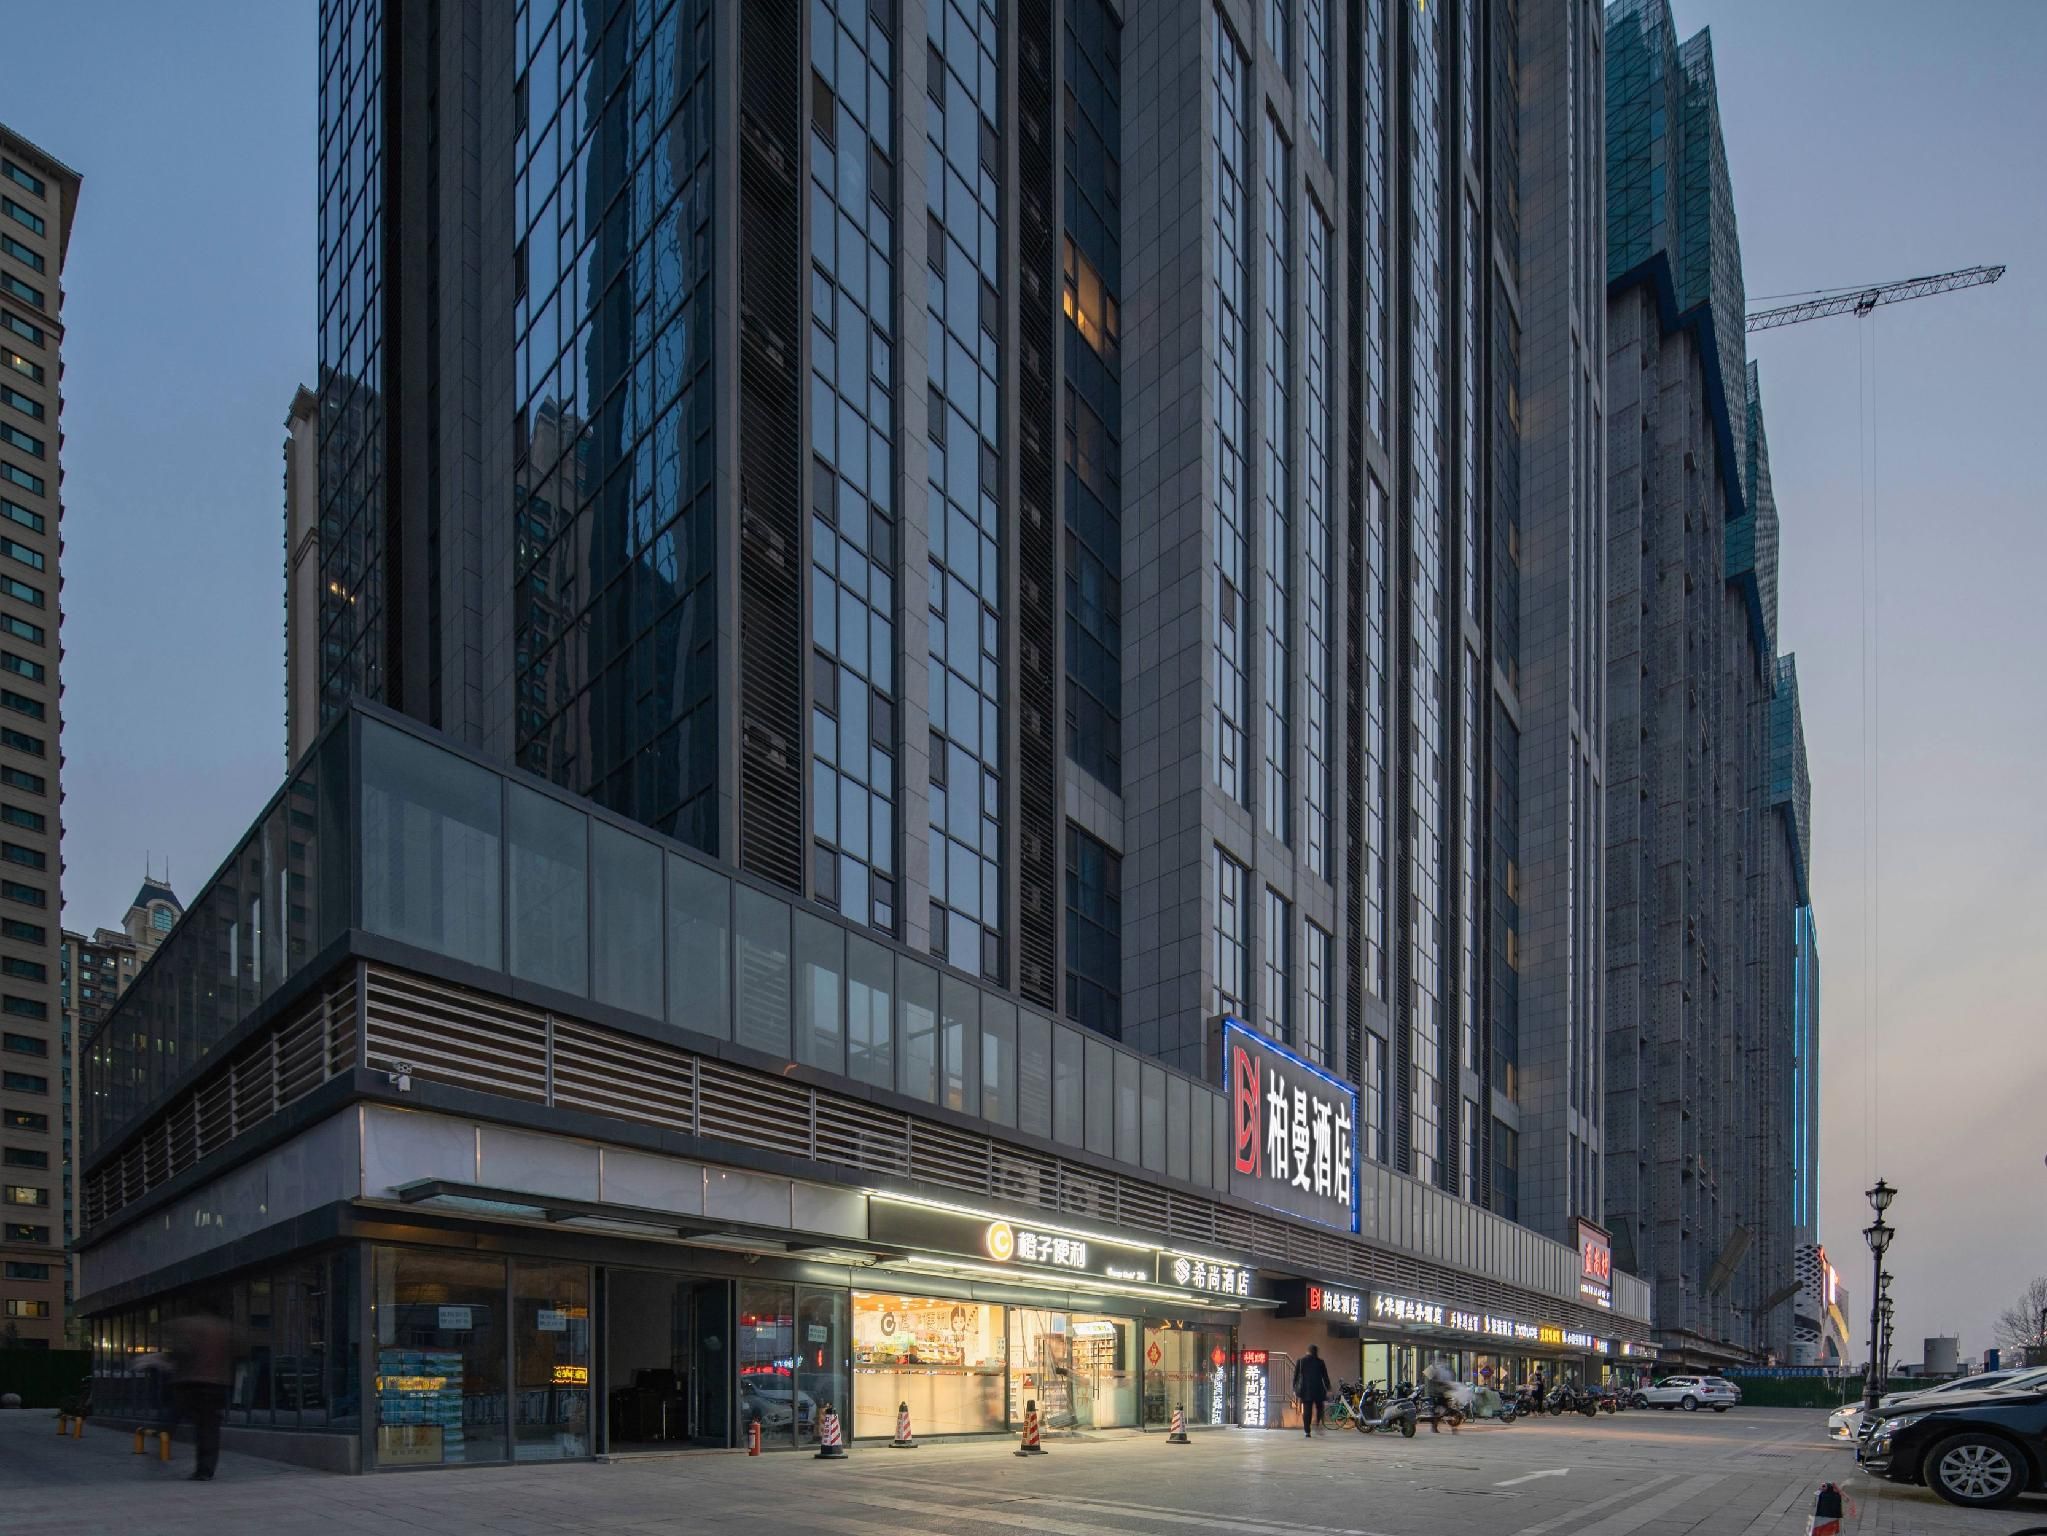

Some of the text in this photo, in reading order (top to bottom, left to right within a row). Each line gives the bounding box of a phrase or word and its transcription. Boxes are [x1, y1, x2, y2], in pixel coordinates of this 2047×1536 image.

[1267, 1069, 1351, 1206] 柏曼酒店
[1018, 1231, 1086, 1268] 橙子便利
[1192, 1261, 1250, 1296] 希尚酒店
[1323, 1290, 1359, 1315] 柏曼酒店
[1244, 1365, 1260, 1425] 希尚酒店
